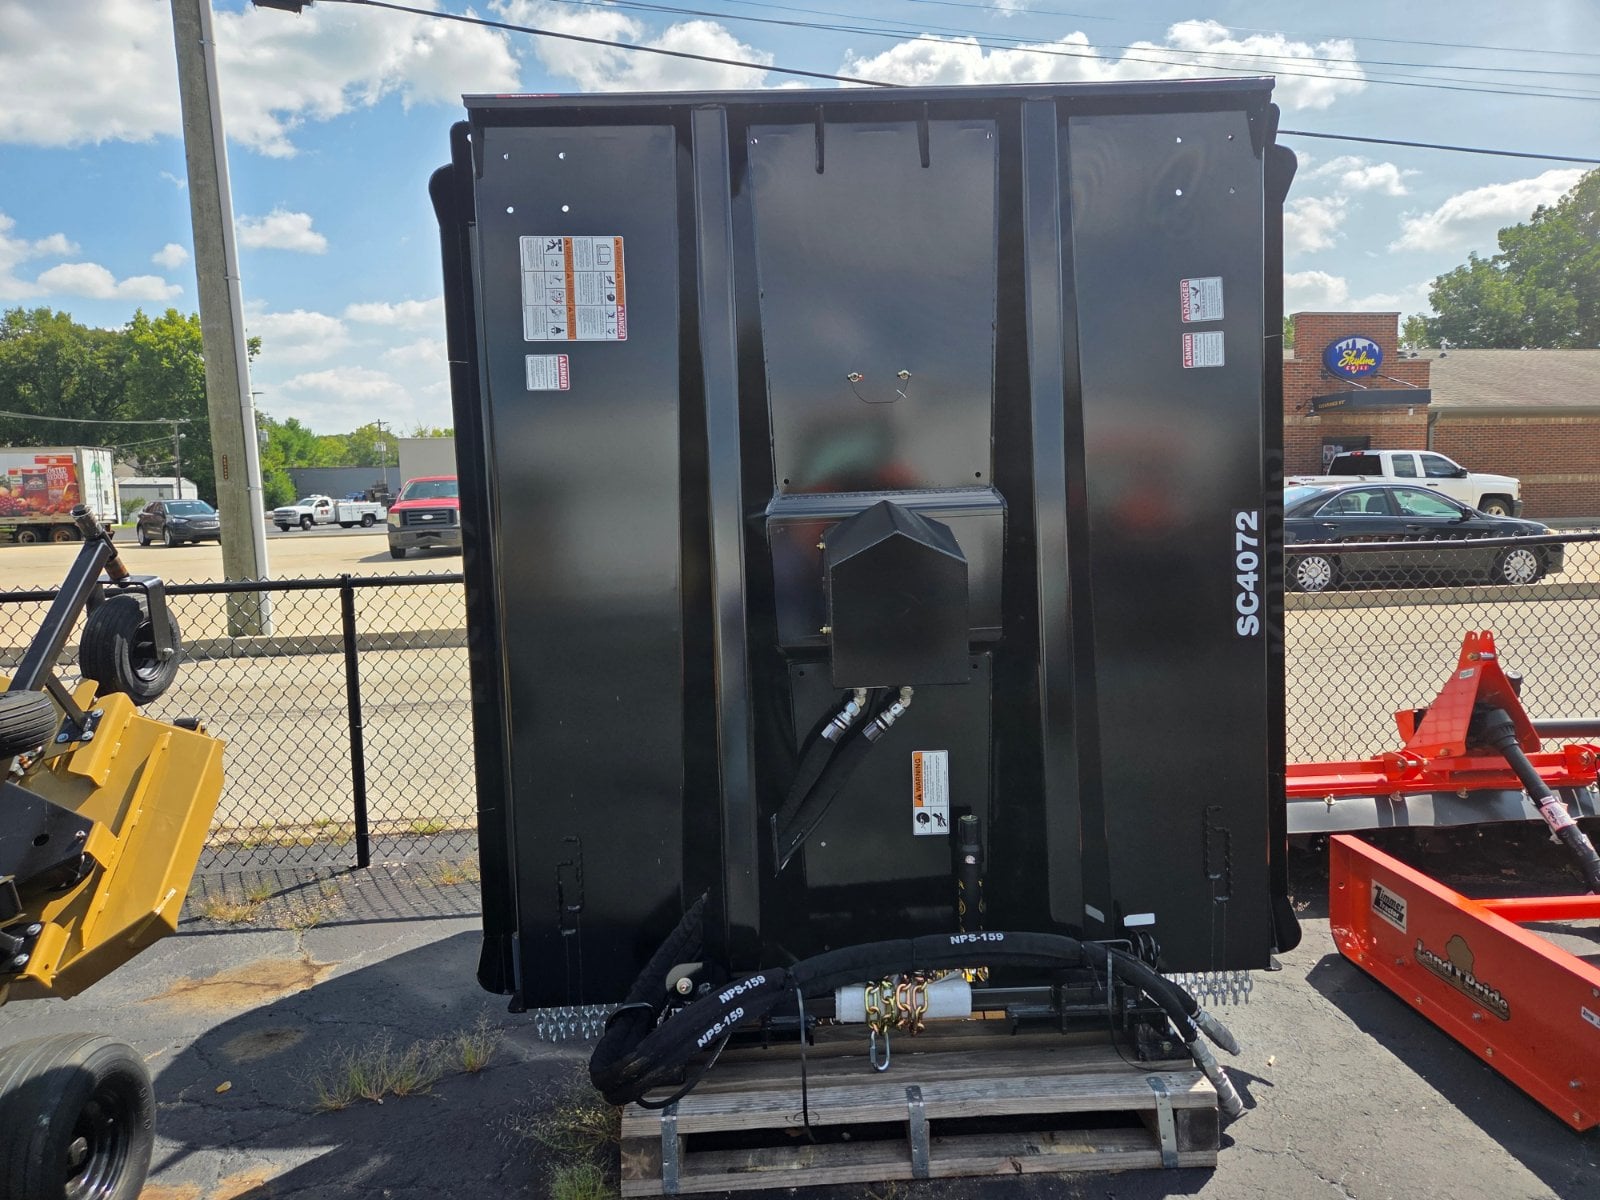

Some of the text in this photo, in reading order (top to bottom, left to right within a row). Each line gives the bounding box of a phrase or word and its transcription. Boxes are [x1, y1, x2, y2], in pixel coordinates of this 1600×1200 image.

[1182, 281, 1190, 313] DANGER
[618, 312, 626, 338] DANGER
[559, 363, 567, 389] DANGER
[1338, 349, 1376, 374] Skyline
[1235, 510, 1260, 636] SC4072
[950, 931, 1005, 946] NPS-159
[718, 973, 767, 1005] NPS-159
[1414, 937, 1509, 1014] Land Pride
[696, 1006, 745, 1048] NPS-159
